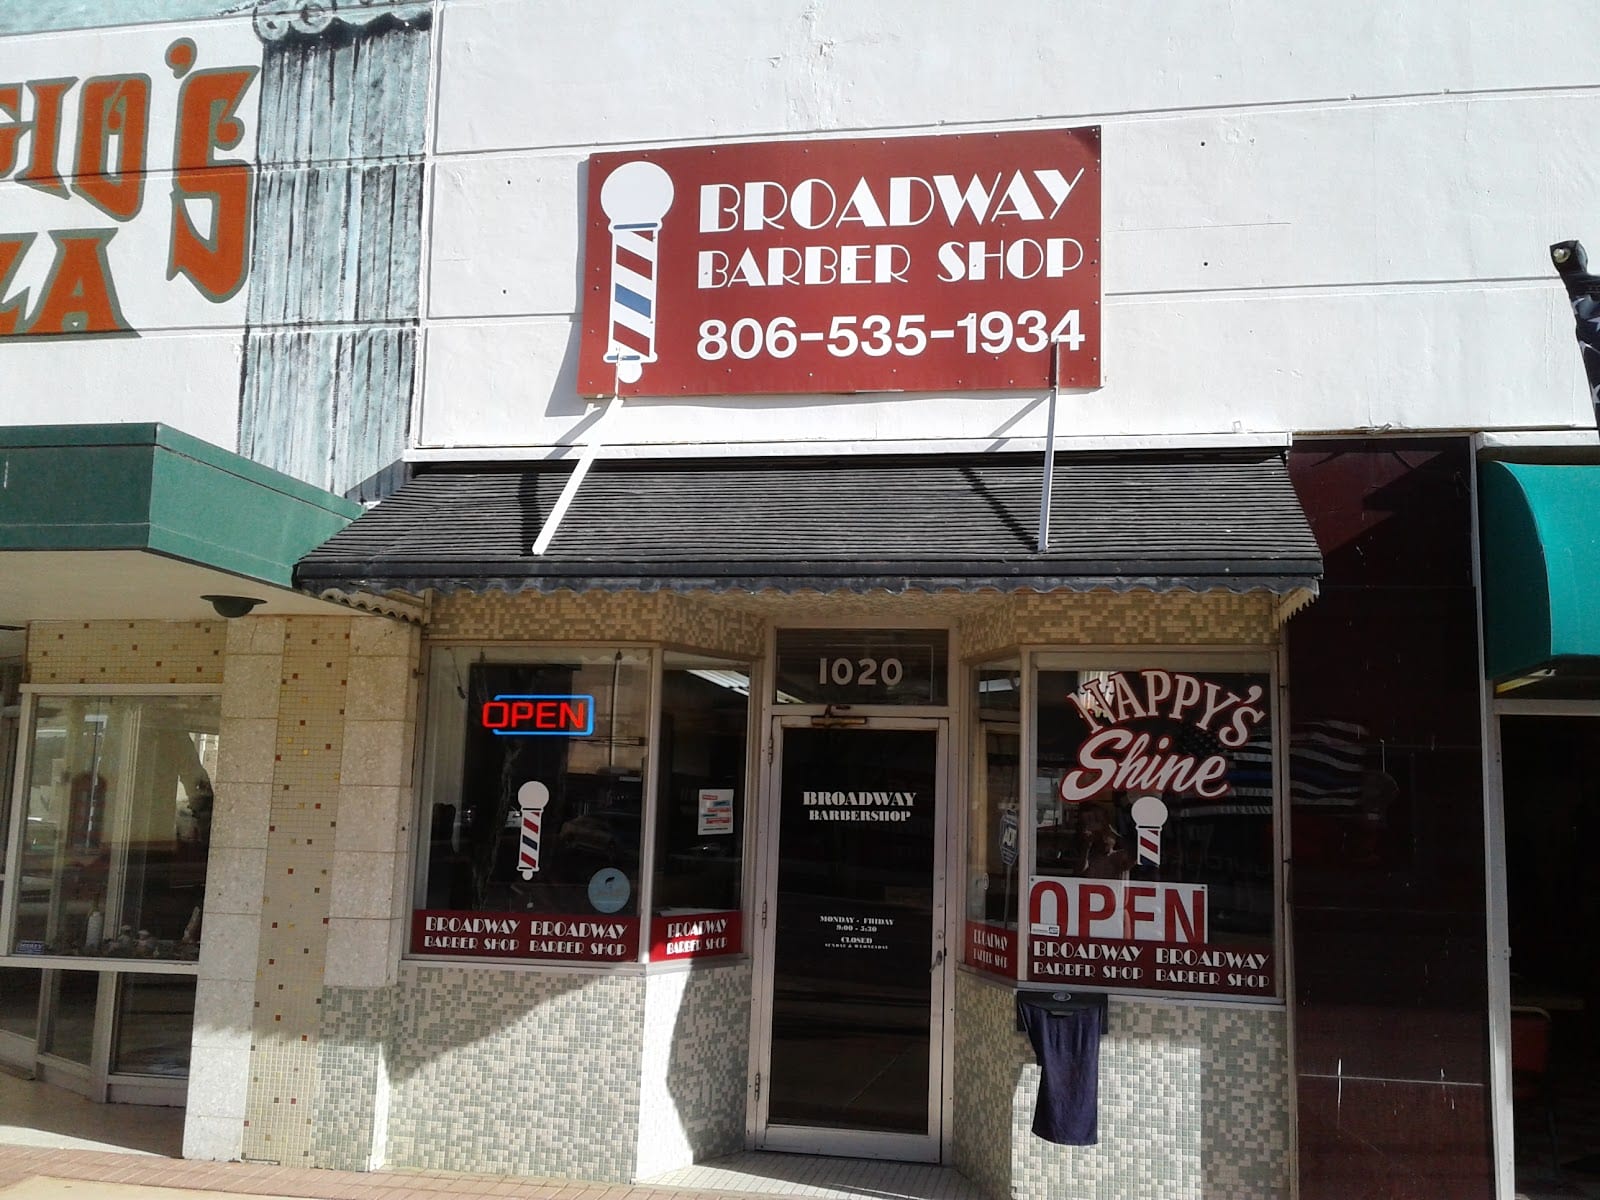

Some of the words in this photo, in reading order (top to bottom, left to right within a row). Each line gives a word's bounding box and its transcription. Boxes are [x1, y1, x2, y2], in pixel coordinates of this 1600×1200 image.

[700, 167, 1085, 233] BROADWAY
[698, 244, 911, 290] BARBER
[937, 238, 1084, 283] SHOP
[697, 309, 1086, 361] 806-535-1934
[817, 657, 904, 685] 1020
[482, 701, 585, 729] OPEN
[1067, 669, 1266, 748] NAPPY'S
[1060, 728, 1231, 803] Shine
[803, 791, 917, 806] BROADWAY
[809, 810, 911, 822] BARBERSHOP
[820, 915, 855, 924] MONDAY
[863, 917, 895, 925] FRIDAY
[1030, 881, 1205, 944] OPEN
[425, 916, 520, 935] BROADWAY
[530, 920, 628, 939] BROADWAY
[667, 918, 728, 938] BROADWAY
[841, 936, 873, 944] CLOSED
[424, 935, 478, 950] BARBER
[484, 938, 519, 951] SHOP
[529, 939, 584, 954] BARBER
[590, 942, 627, 956] SHOP
[666, 939, 702, 955] BARBER
[705, 937, 728, 950] SHOP
[1033, 940, 1143, 962] BROADWAY
[1156, 947, 1269, 969] BROADWAY
[1033, 961, 1095, 978] BARBER
[1102, 965, 1143, 980] SHOP
[1156, 969, 1220, 985] BARBER
[1227, 973, 1270, 988] SHOP
